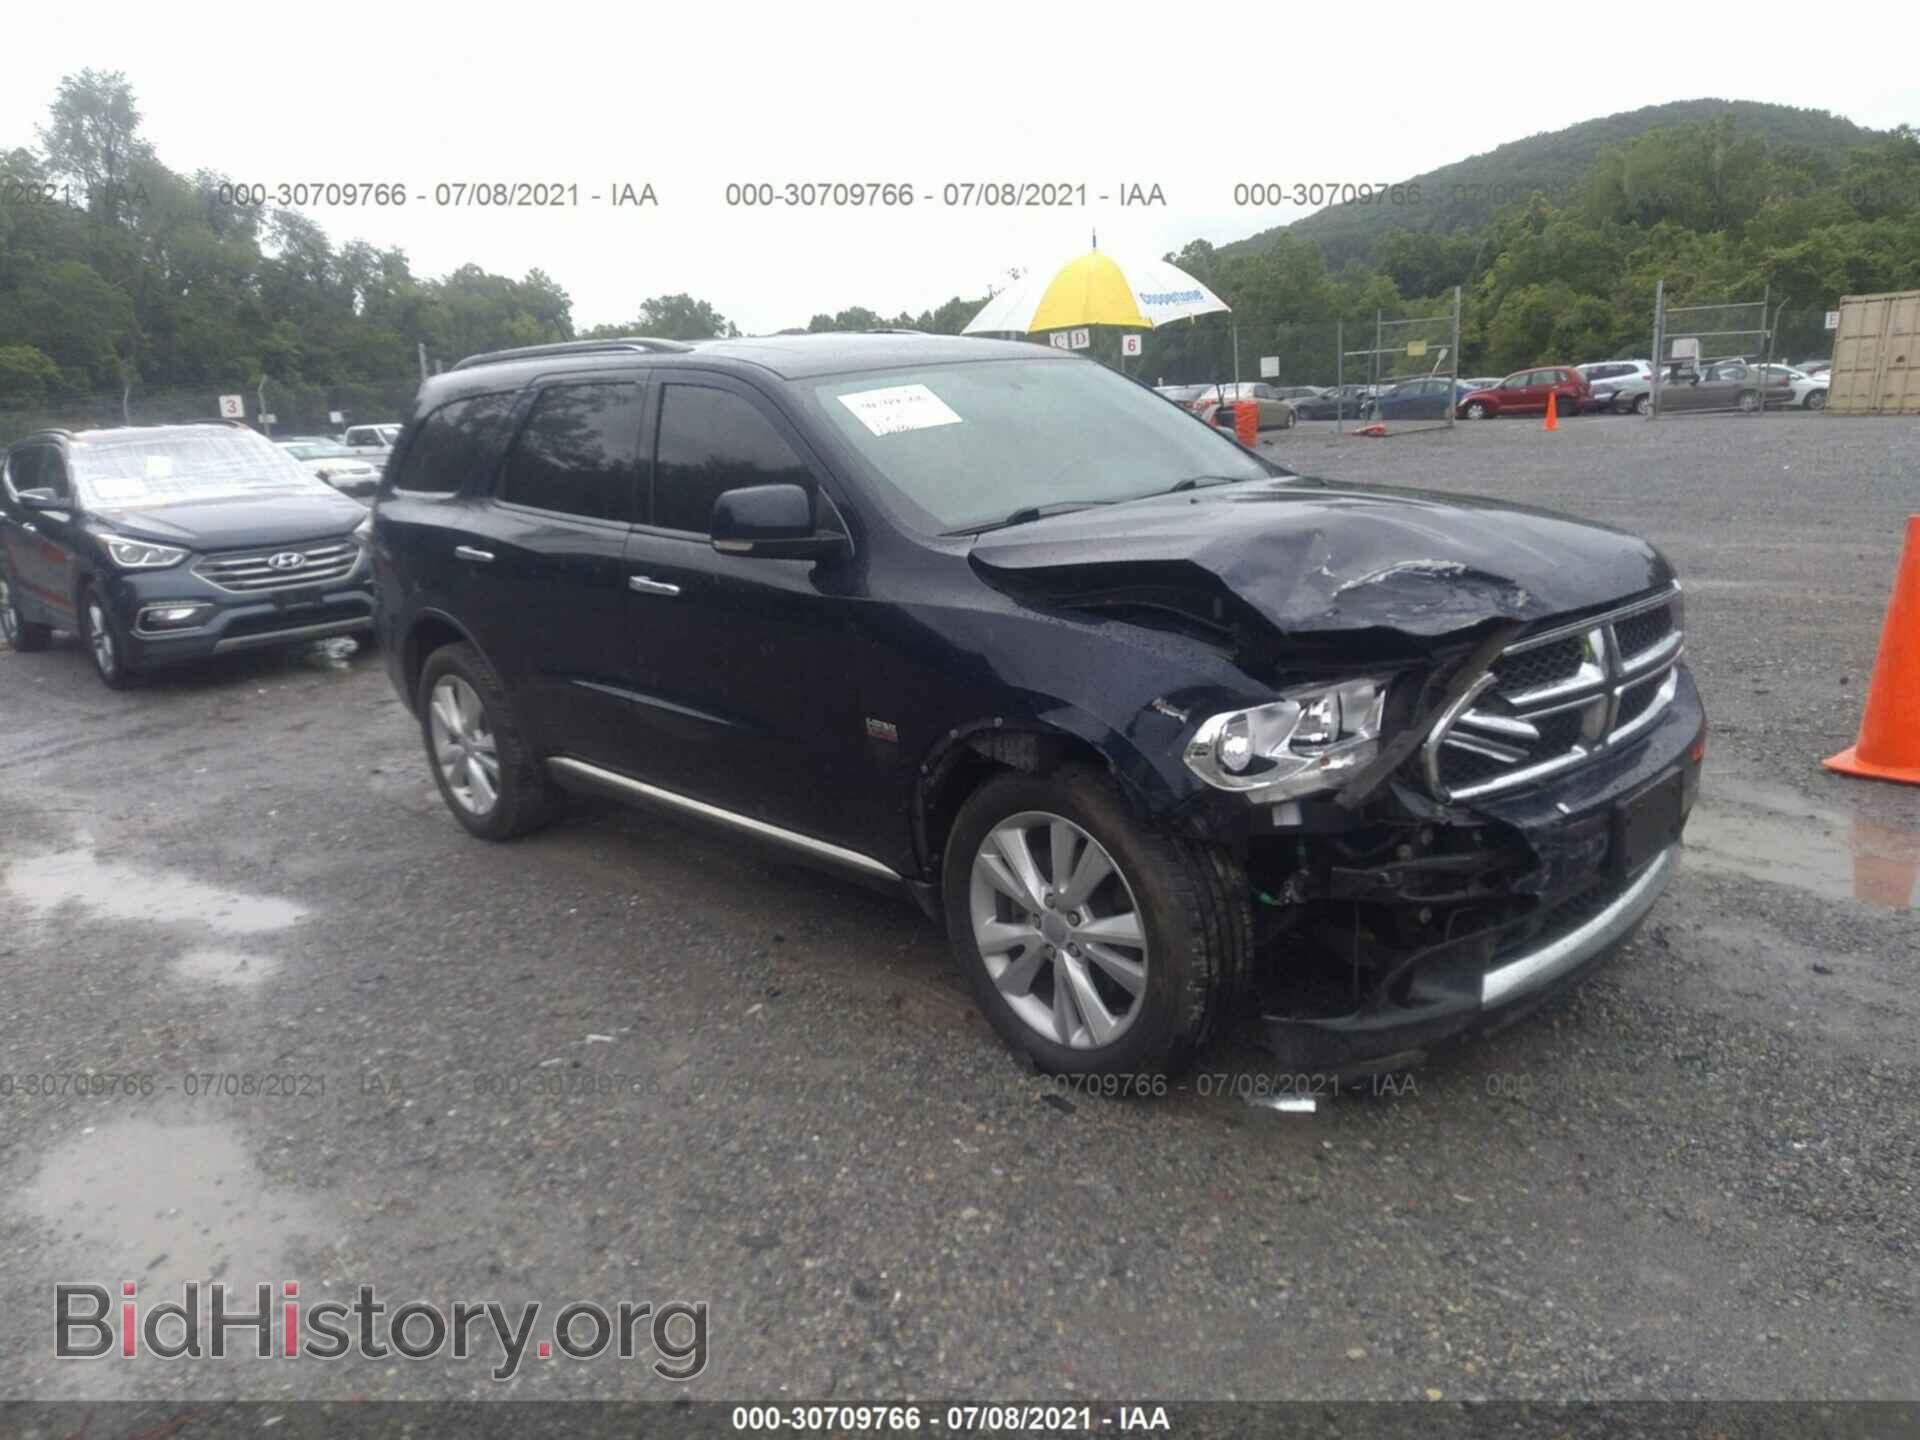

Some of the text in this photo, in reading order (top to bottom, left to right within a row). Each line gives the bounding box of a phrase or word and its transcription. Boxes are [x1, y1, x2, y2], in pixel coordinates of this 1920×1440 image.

[1074, 332, 1087, 345] D
[1127, 338, 1137, 352] 6
[226, 399, 237, 414] 3
